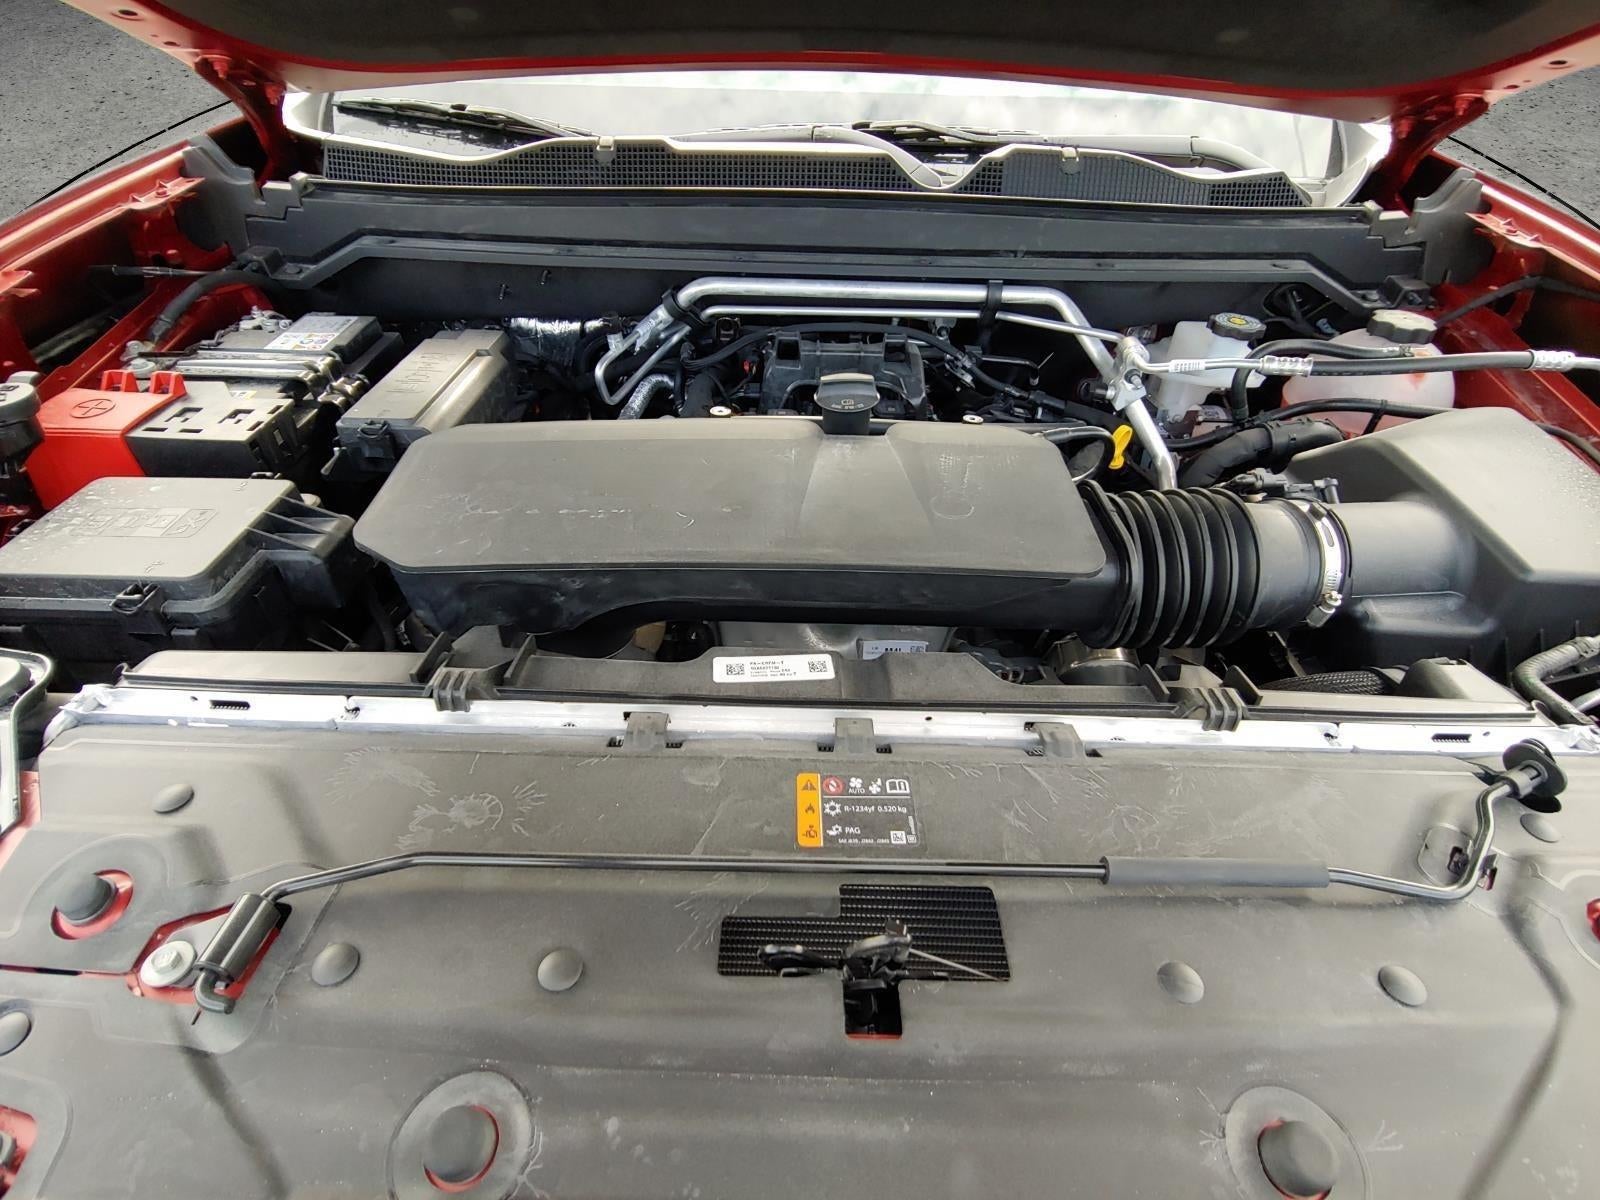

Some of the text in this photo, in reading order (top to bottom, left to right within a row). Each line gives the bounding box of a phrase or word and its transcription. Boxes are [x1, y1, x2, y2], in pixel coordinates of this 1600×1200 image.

[844, 804, 907, 813] R-1234yf 0.520 kg
[845, 826, 861, 834] PAG
